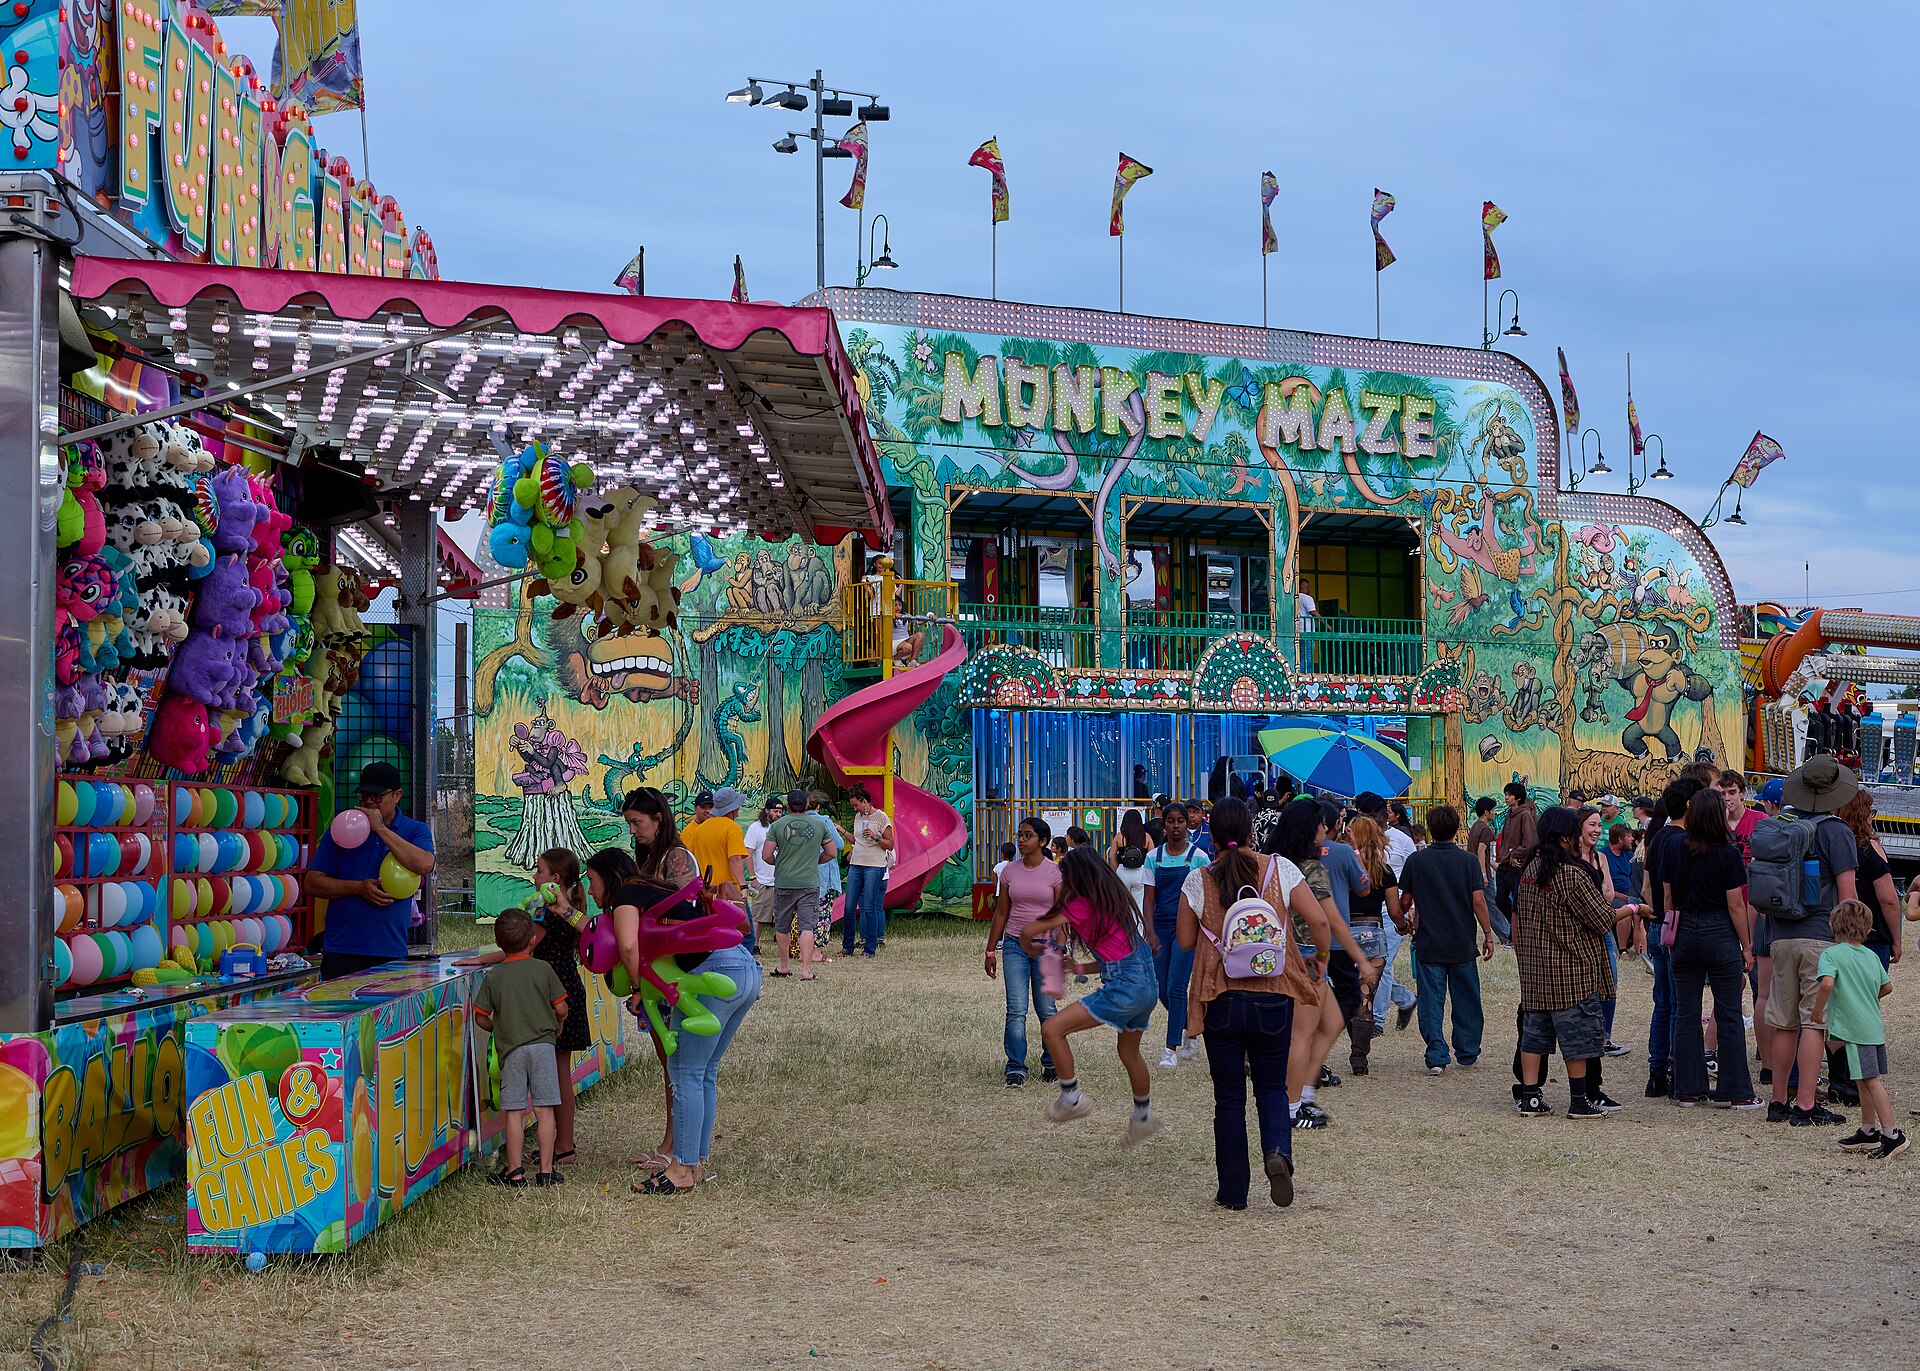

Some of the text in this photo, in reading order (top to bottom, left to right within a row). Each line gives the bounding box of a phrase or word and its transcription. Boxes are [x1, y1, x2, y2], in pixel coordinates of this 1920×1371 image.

[118, 0, 261, 267] FUN
[939, 351, 1437, 458] MONKEY MAZE
[275, 683, 313, 721] CHOICE
[43, 1035, 186, 1197] BALLO
[190, 1068, 320, 1169] FUN &
[379, 1003, 464, 1197] FUN
[194, 1128, 338, 1233] GAMES
